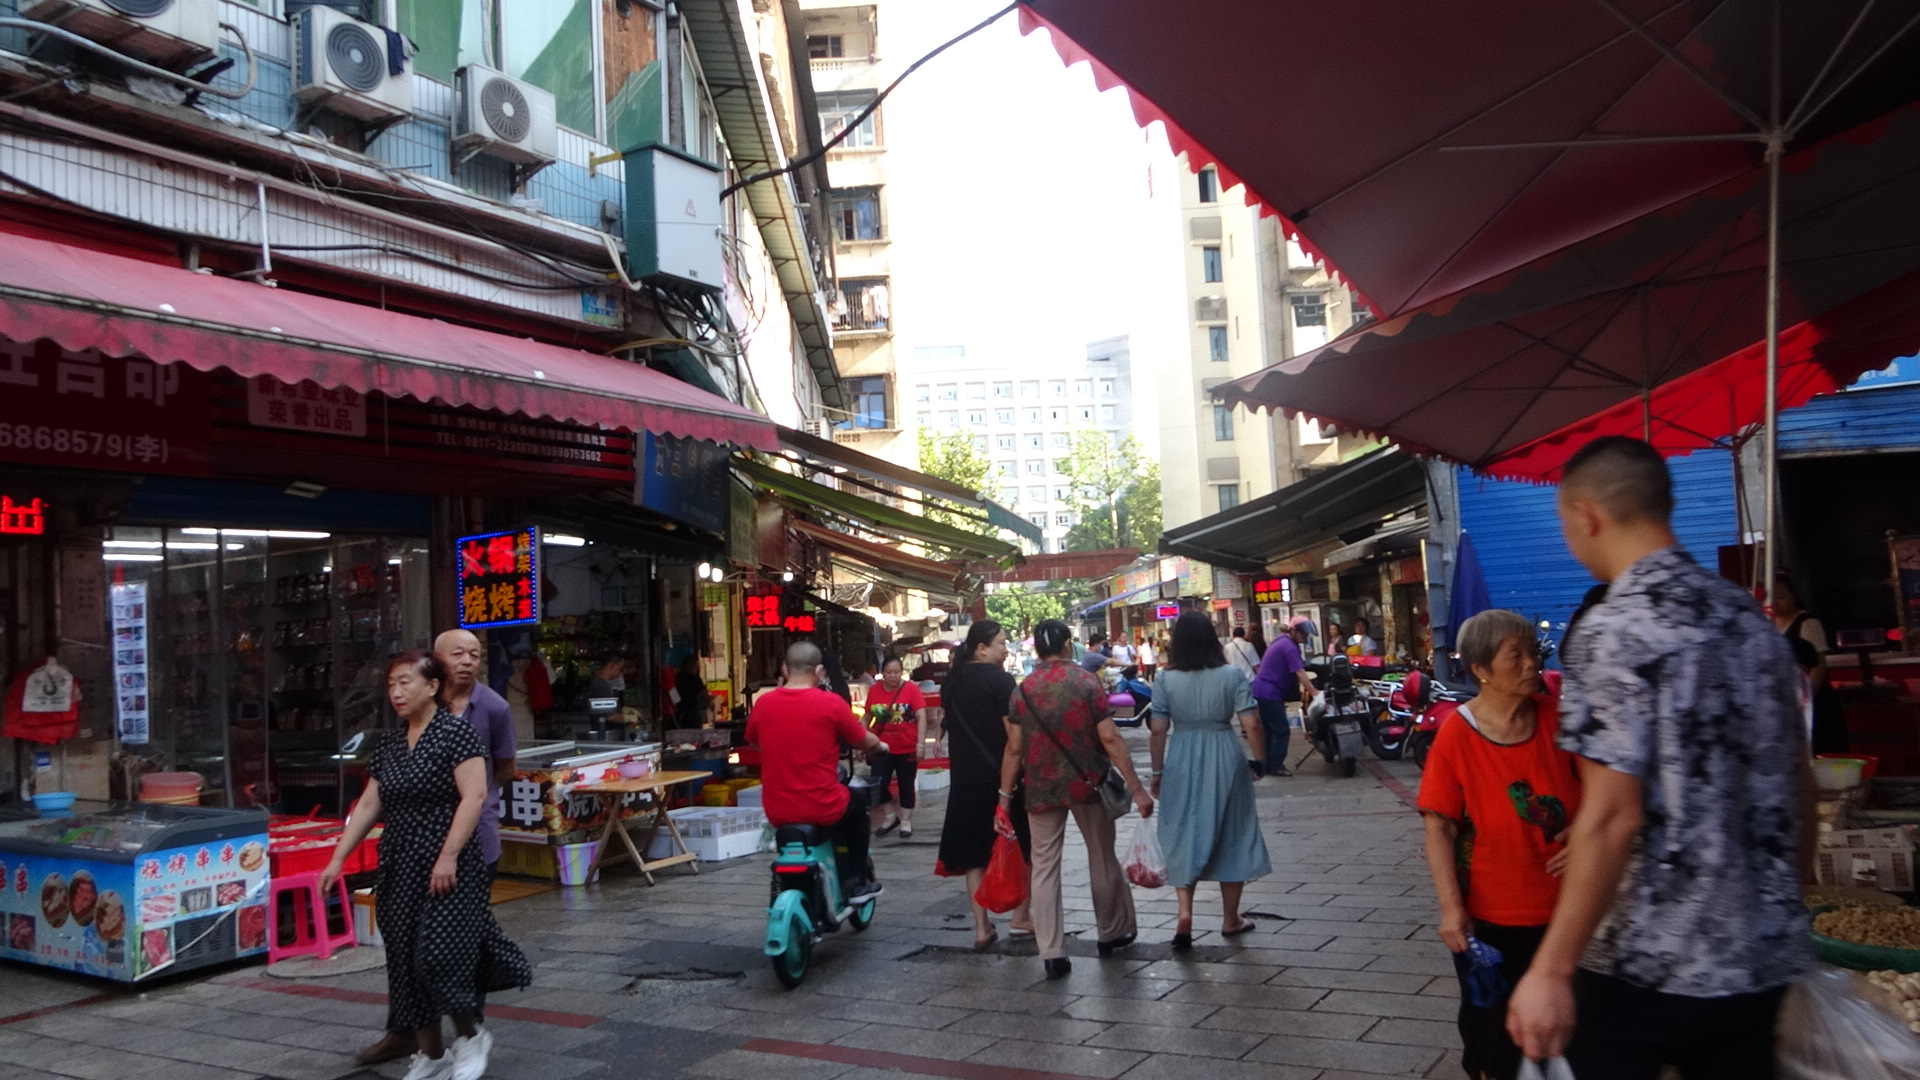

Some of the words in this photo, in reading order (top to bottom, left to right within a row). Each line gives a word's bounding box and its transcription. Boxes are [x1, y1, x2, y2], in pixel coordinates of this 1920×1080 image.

[268, 400, 353, 432] 荣誉出品
[461, 535, 515, 580] 火锅
[462, 582, 516, 623] 烧烤
[498, 778, 544, 826] 串
[141, 844, 236, 880] 烧烤串串
